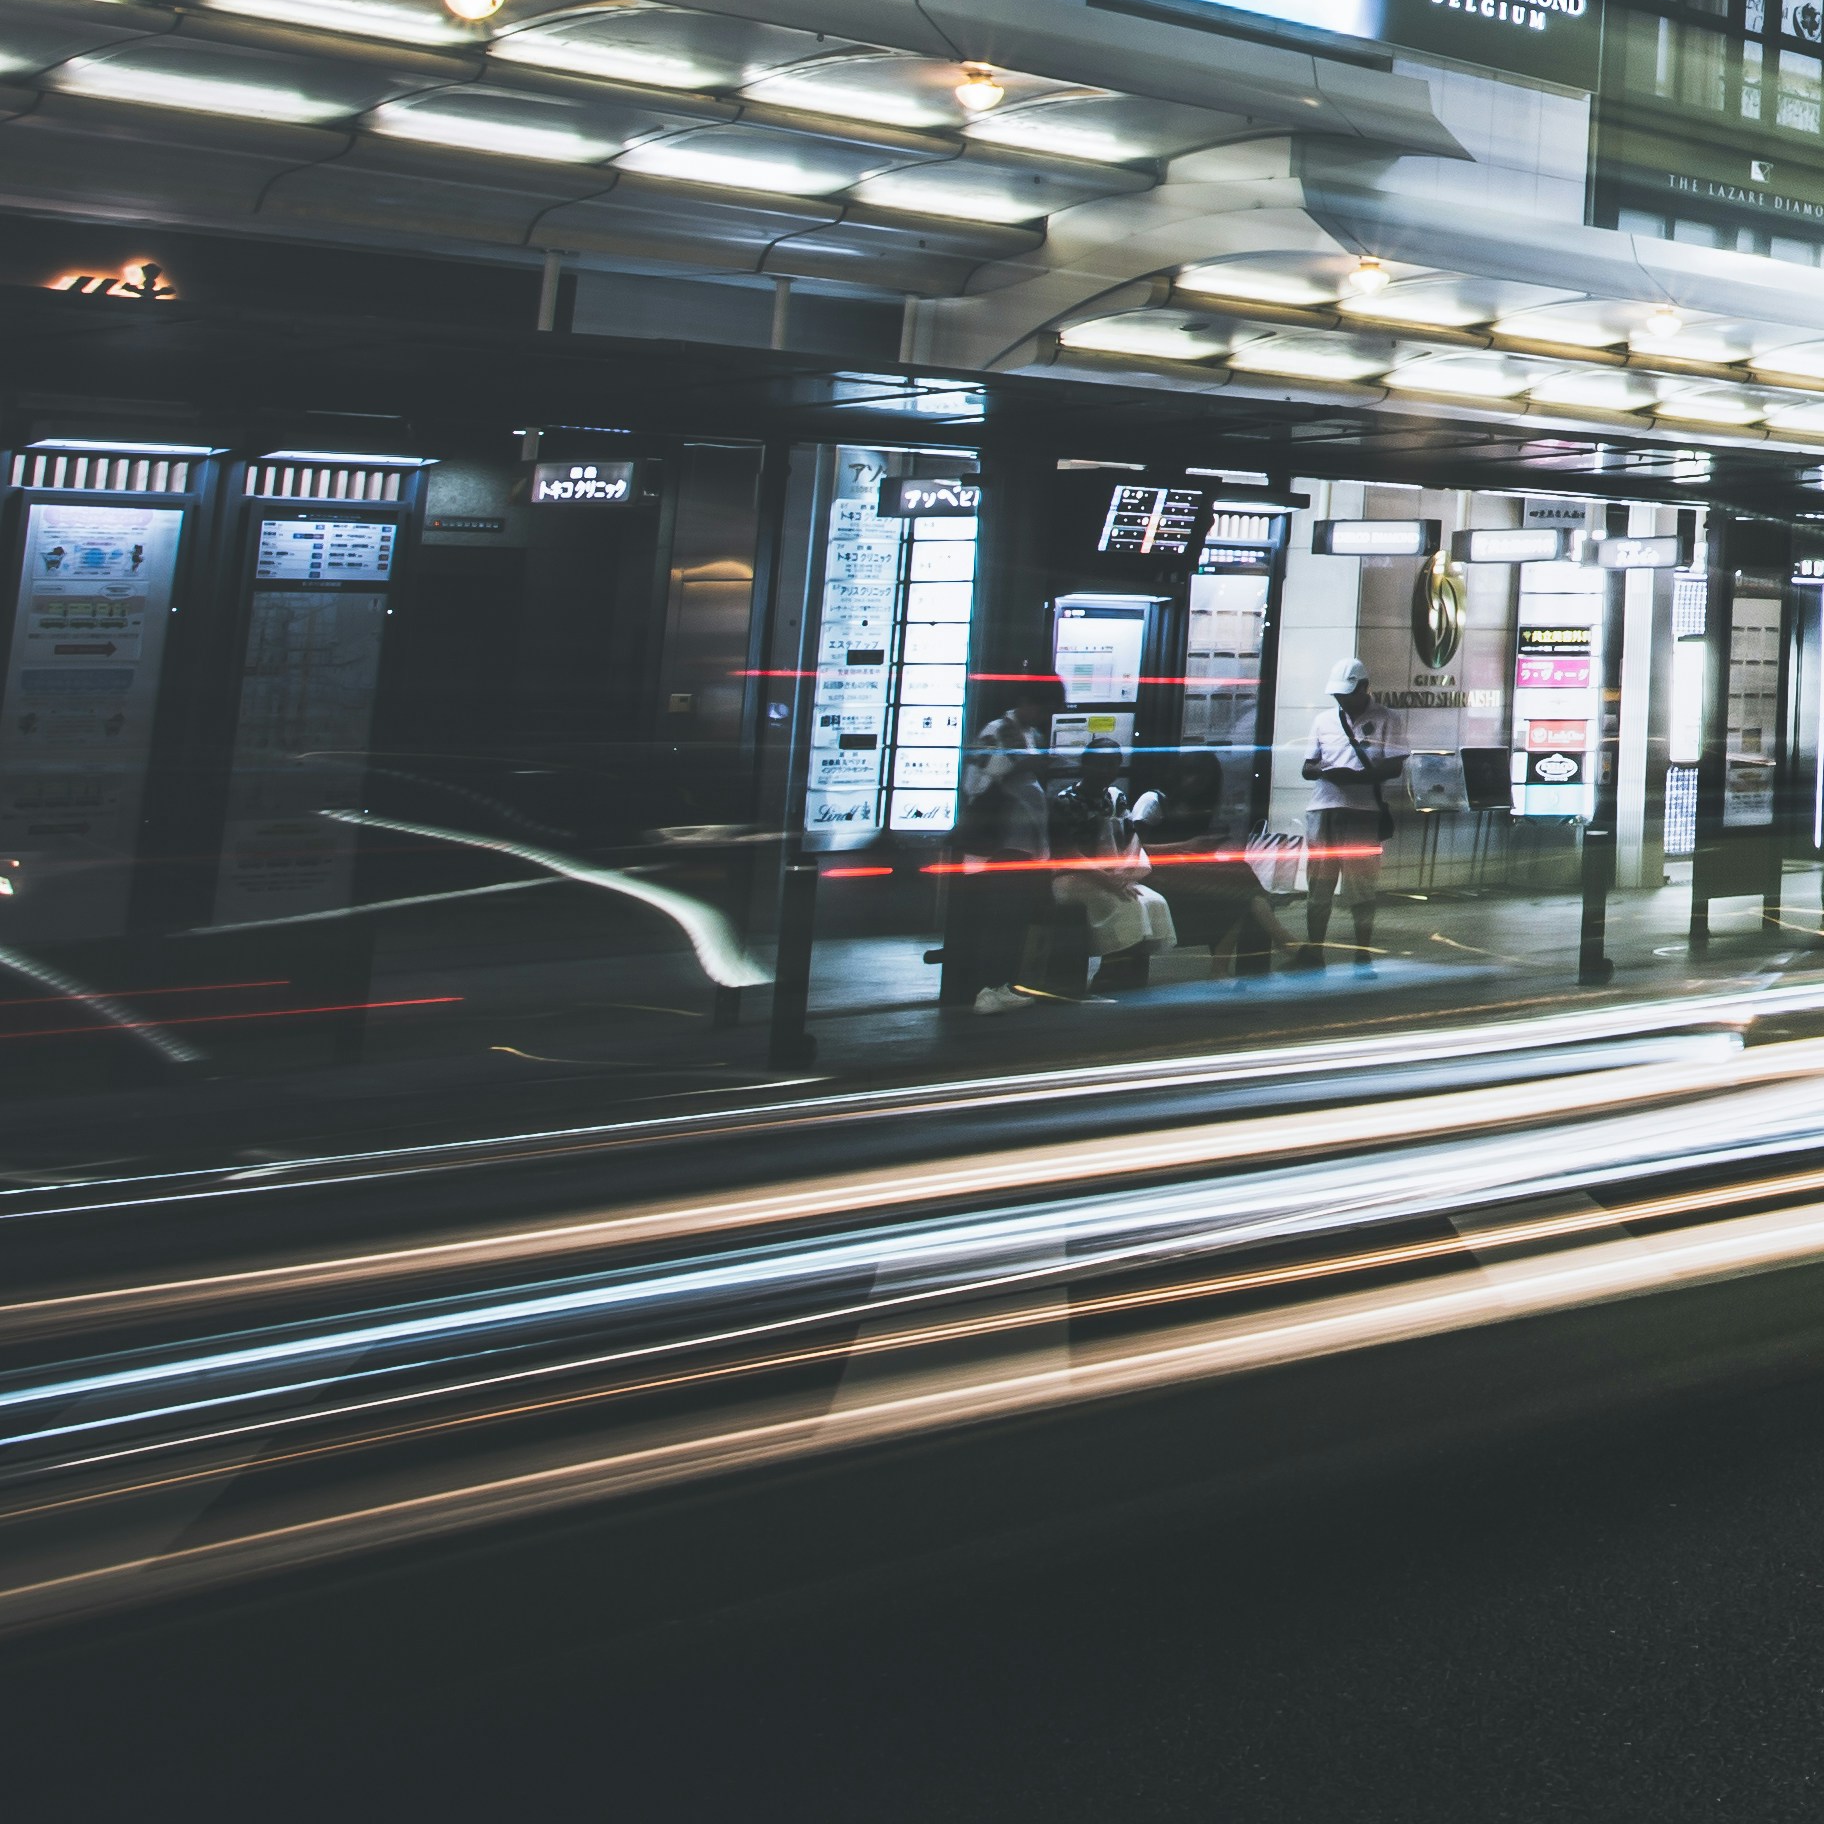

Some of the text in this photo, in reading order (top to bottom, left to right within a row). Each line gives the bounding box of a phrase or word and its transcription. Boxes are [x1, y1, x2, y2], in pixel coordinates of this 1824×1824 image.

[1669, 174, 1699, 193] THE
[1708, 182, 1765, 207] LAZARE
[1414, 674, 1456, 687] GINZA
